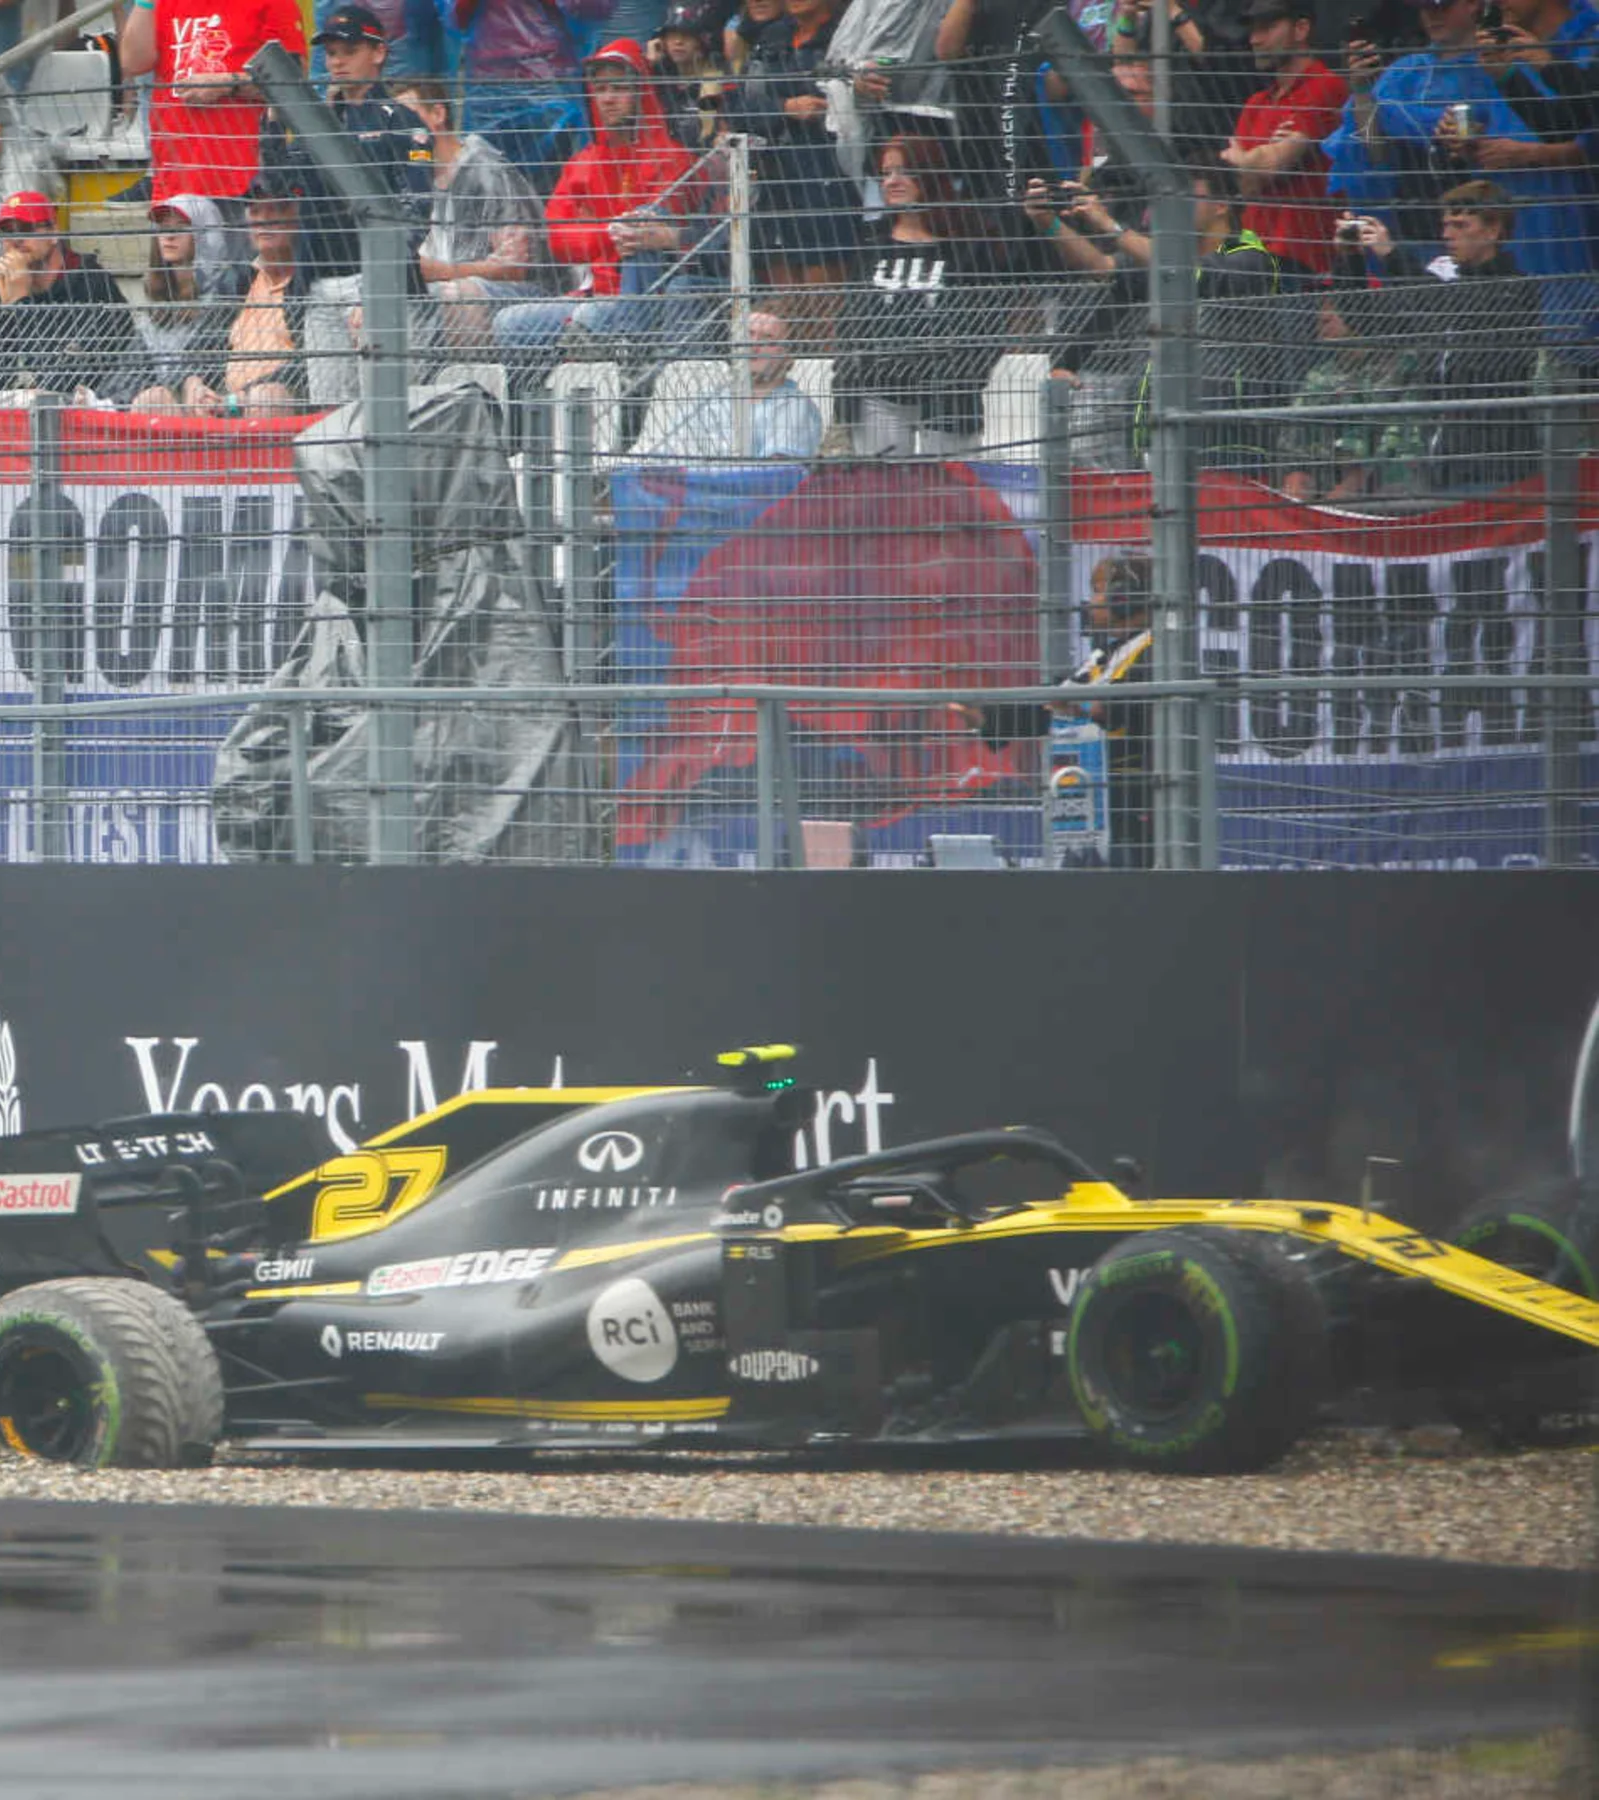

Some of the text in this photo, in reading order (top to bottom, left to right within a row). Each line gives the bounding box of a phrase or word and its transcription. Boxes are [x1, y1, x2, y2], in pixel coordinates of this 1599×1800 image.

[310, 1146, 447, 1243] 27
[537, 1187, 677, 1210] INFINITI
[449, 1248, 558, 1285] EDGE
[346, 1331, 445, 1351] RENAULT
[740, 1351, 807, 1381] DUPONT
